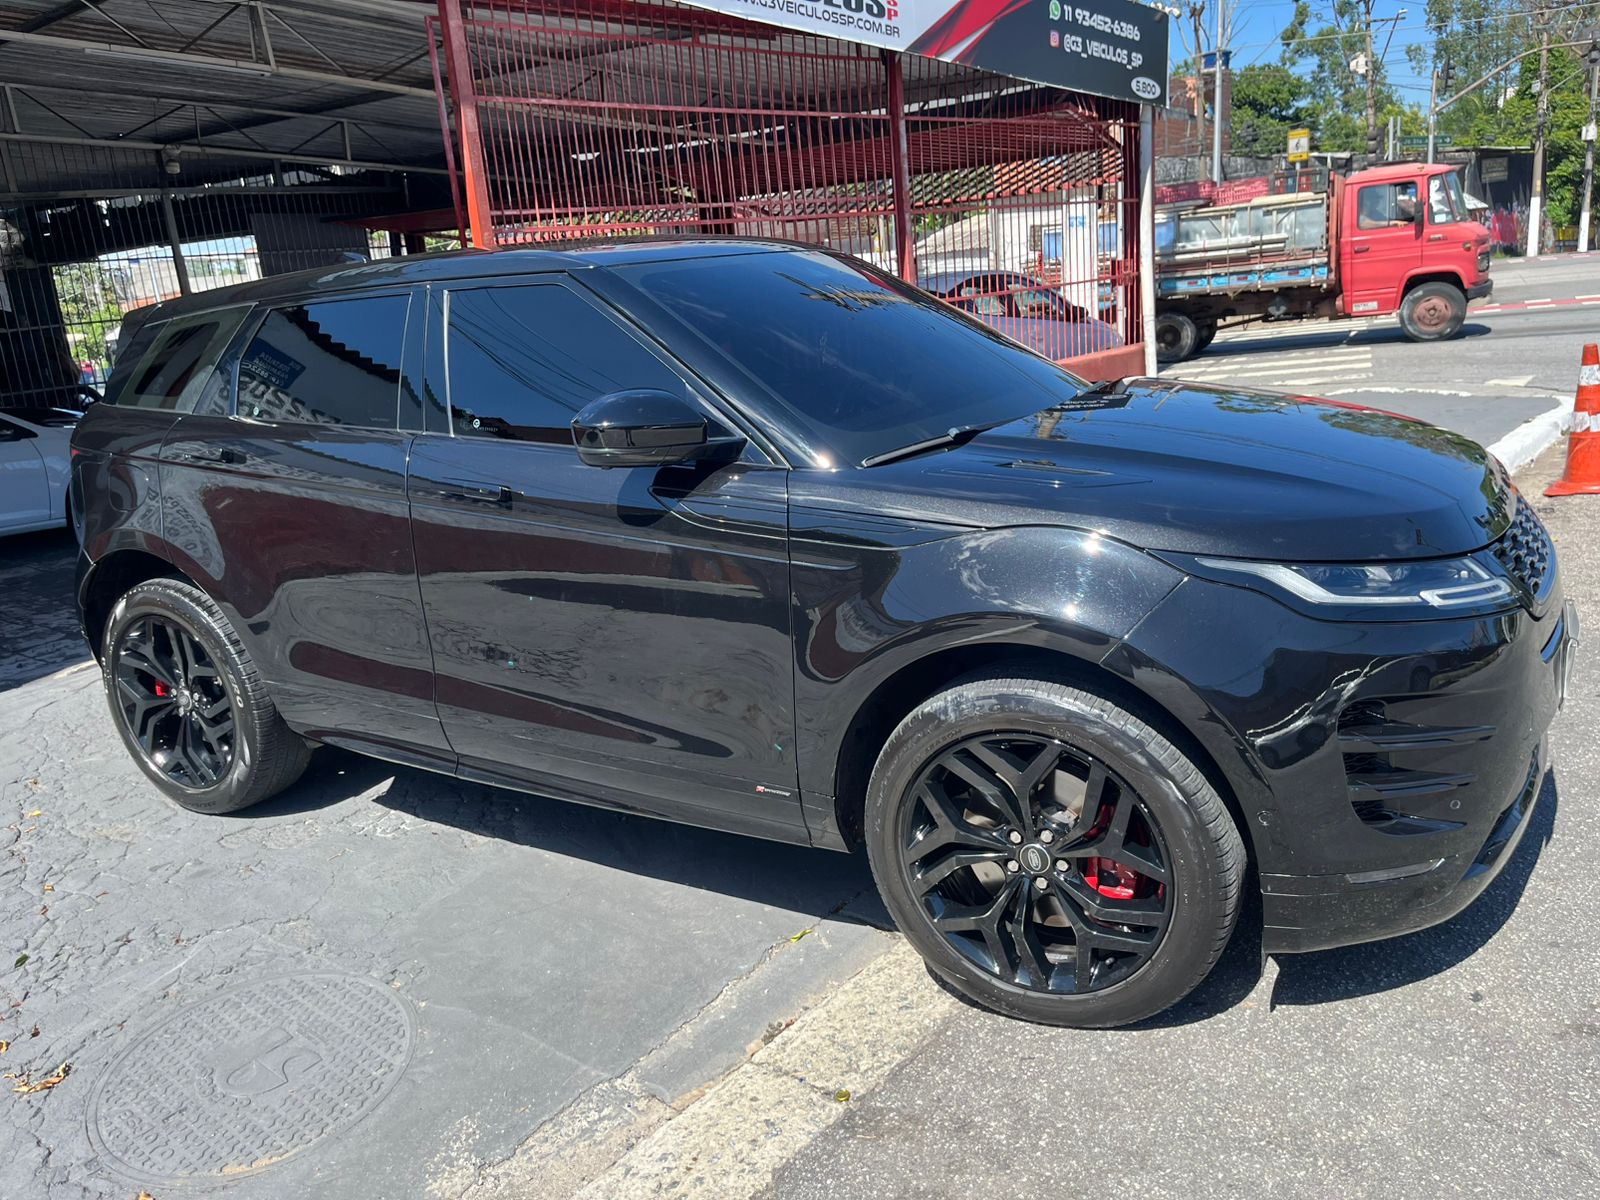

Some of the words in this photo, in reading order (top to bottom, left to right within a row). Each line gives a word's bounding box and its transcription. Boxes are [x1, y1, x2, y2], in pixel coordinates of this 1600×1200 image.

[1063, 4, 1073, 22] 11
[1075, 7, 1141, 42] 93452-6386
[1063, 33, 1143, 70] @G3_VEICULOS_SP
